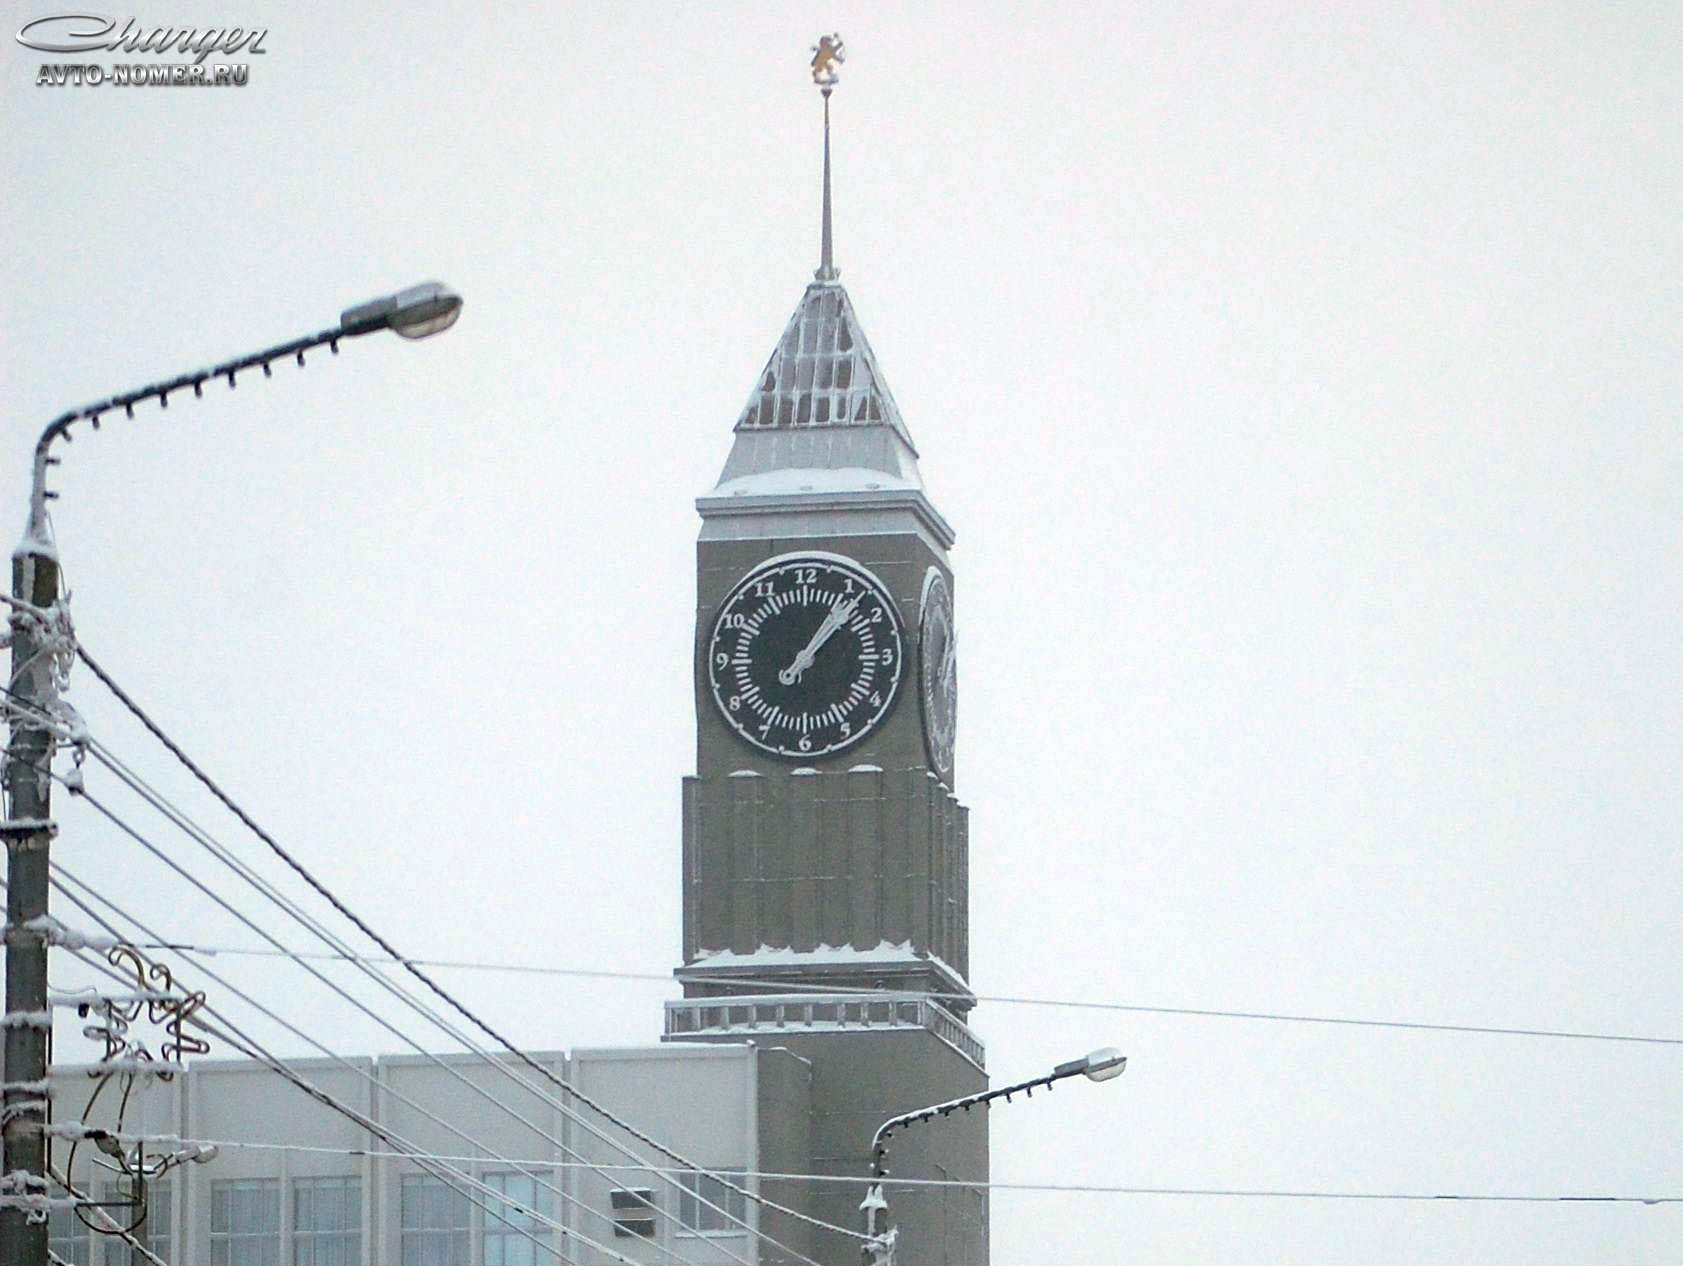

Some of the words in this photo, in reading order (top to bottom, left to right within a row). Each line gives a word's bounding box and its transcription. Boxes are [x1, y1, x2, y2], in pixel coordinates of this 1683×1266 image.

[794, 569, 817, 584] 12
[754, 582, 775, 597] 11
[844, 579, 855, 593] 1
[724, 614, 744, 629] 10
[871, 608, 882, 623] 2
[716, 652, 729, 670] 9
[881, 648, 893, 665] 3
[729, 696, 740, 711] 8
[869, 691, 881, 707] 4
[758, 724, 770, 739] 7
[840, 722, 851, 738] 5
[799, 735, 812, 750] 6
